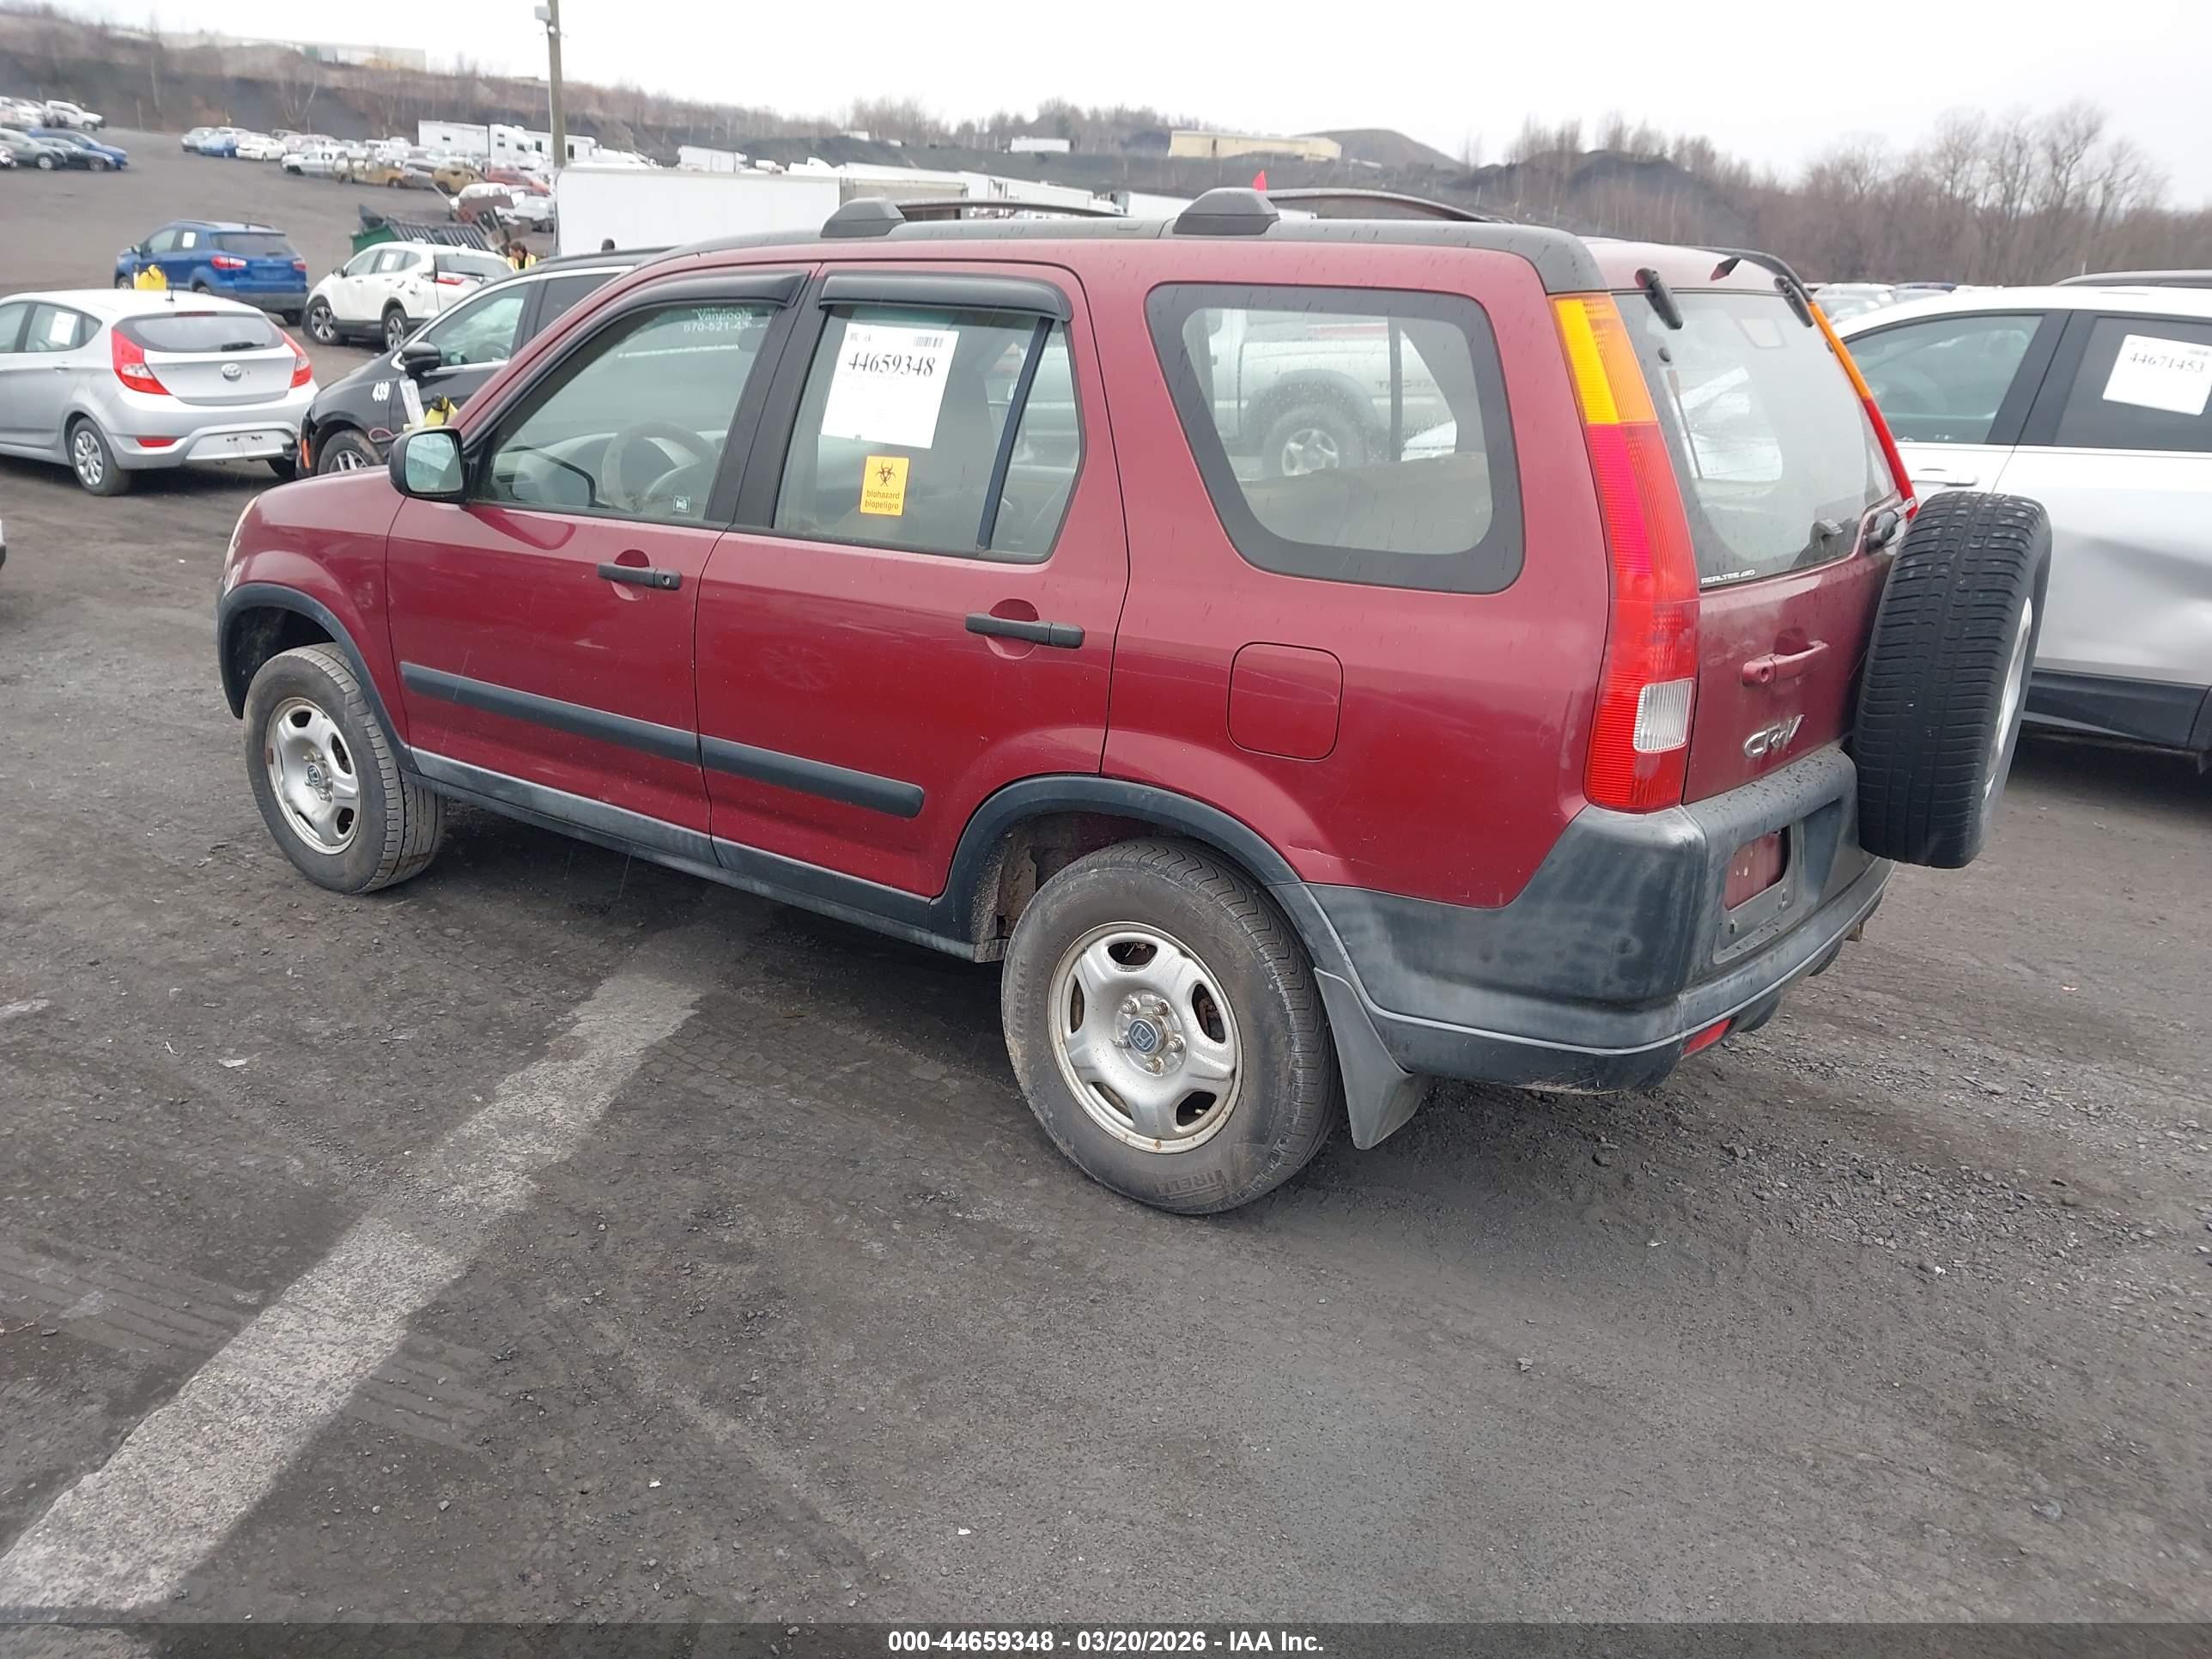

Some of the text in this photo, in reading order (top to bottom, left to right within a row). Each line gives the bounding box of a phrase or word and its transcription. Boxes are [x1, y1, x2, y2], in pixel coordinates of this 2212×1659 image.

[848, 351, 936, 378] 44659348
[866, 489, 901, 500] biohazard
[865, 500, 900, 511] biopeligro
